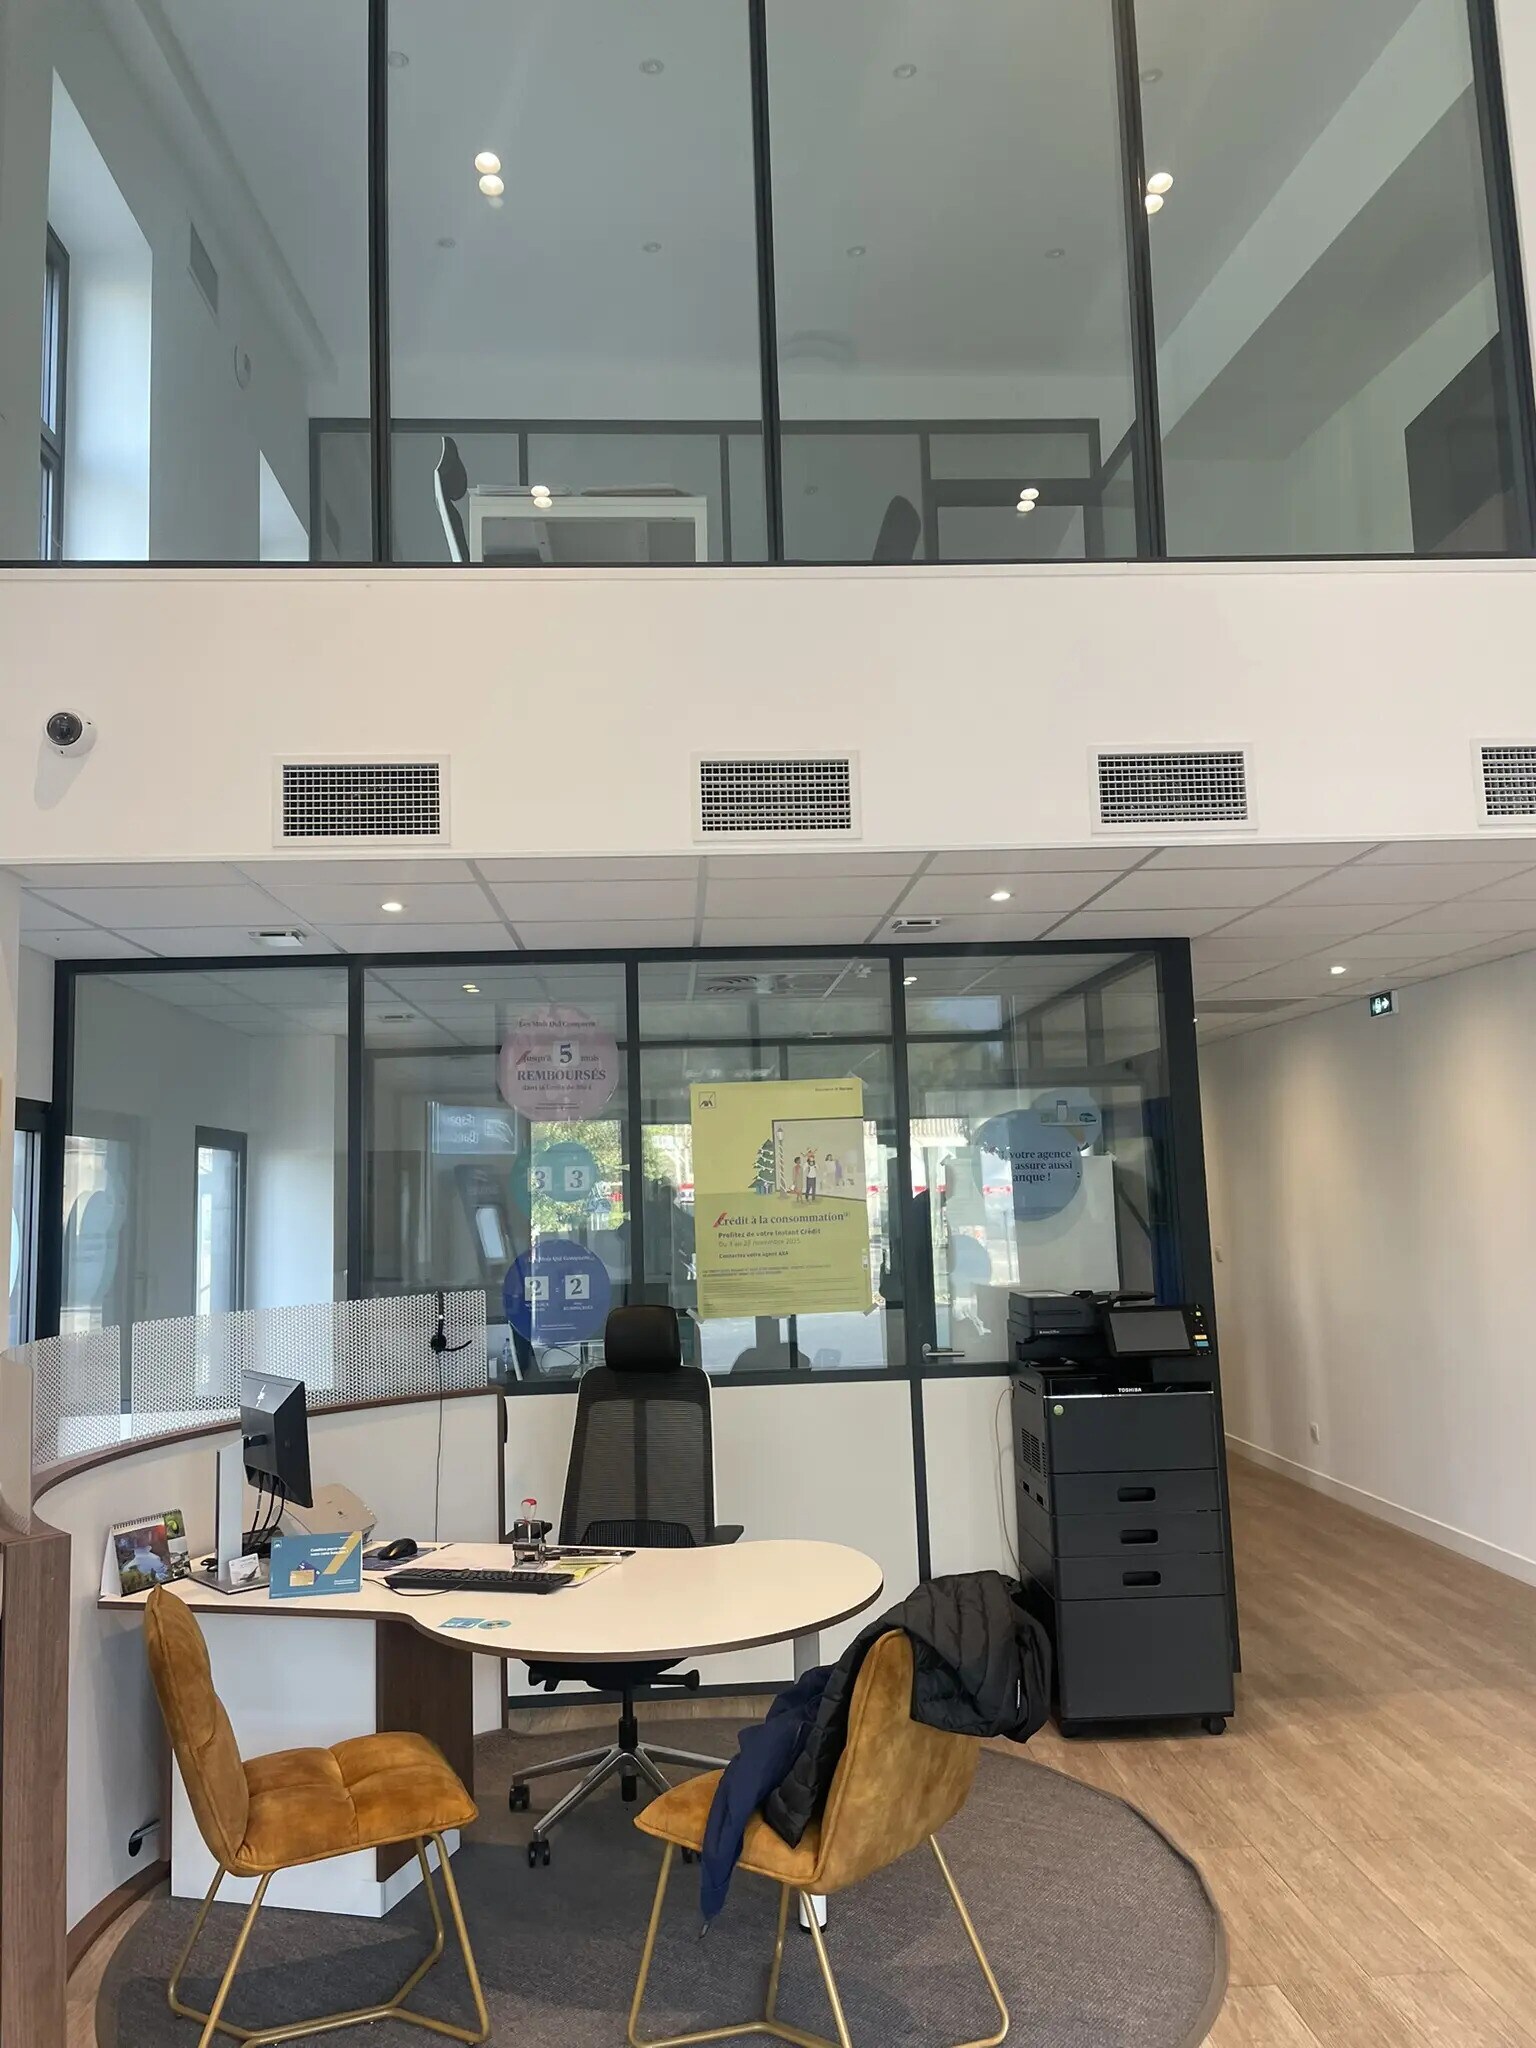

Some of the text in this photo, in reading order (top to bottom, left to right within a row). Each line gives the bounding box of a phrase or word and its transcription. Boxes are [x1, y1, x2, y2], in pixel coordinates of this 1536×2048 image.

[560, 1042, 573, 1064] 5
[517, 1068, 606, 1081] REMBOURSÉS
[1009, 1151, 1037, 1159] votre
[1037, 1151, 1072, 1160] agence
[1014, 1160, 1073, 1170] assure aussi
[535, 1169, 584, 1190] 3 3
[1012, 1173, 1046, 1184] anque
[717, 1214, 749, 1227] Crédit
[751, 1215, 757, 1225] à
[759, 1215, 769, 1225] la
[747, 1230, 755, 1238] de
[570, 1277, 583, 1296] 2
